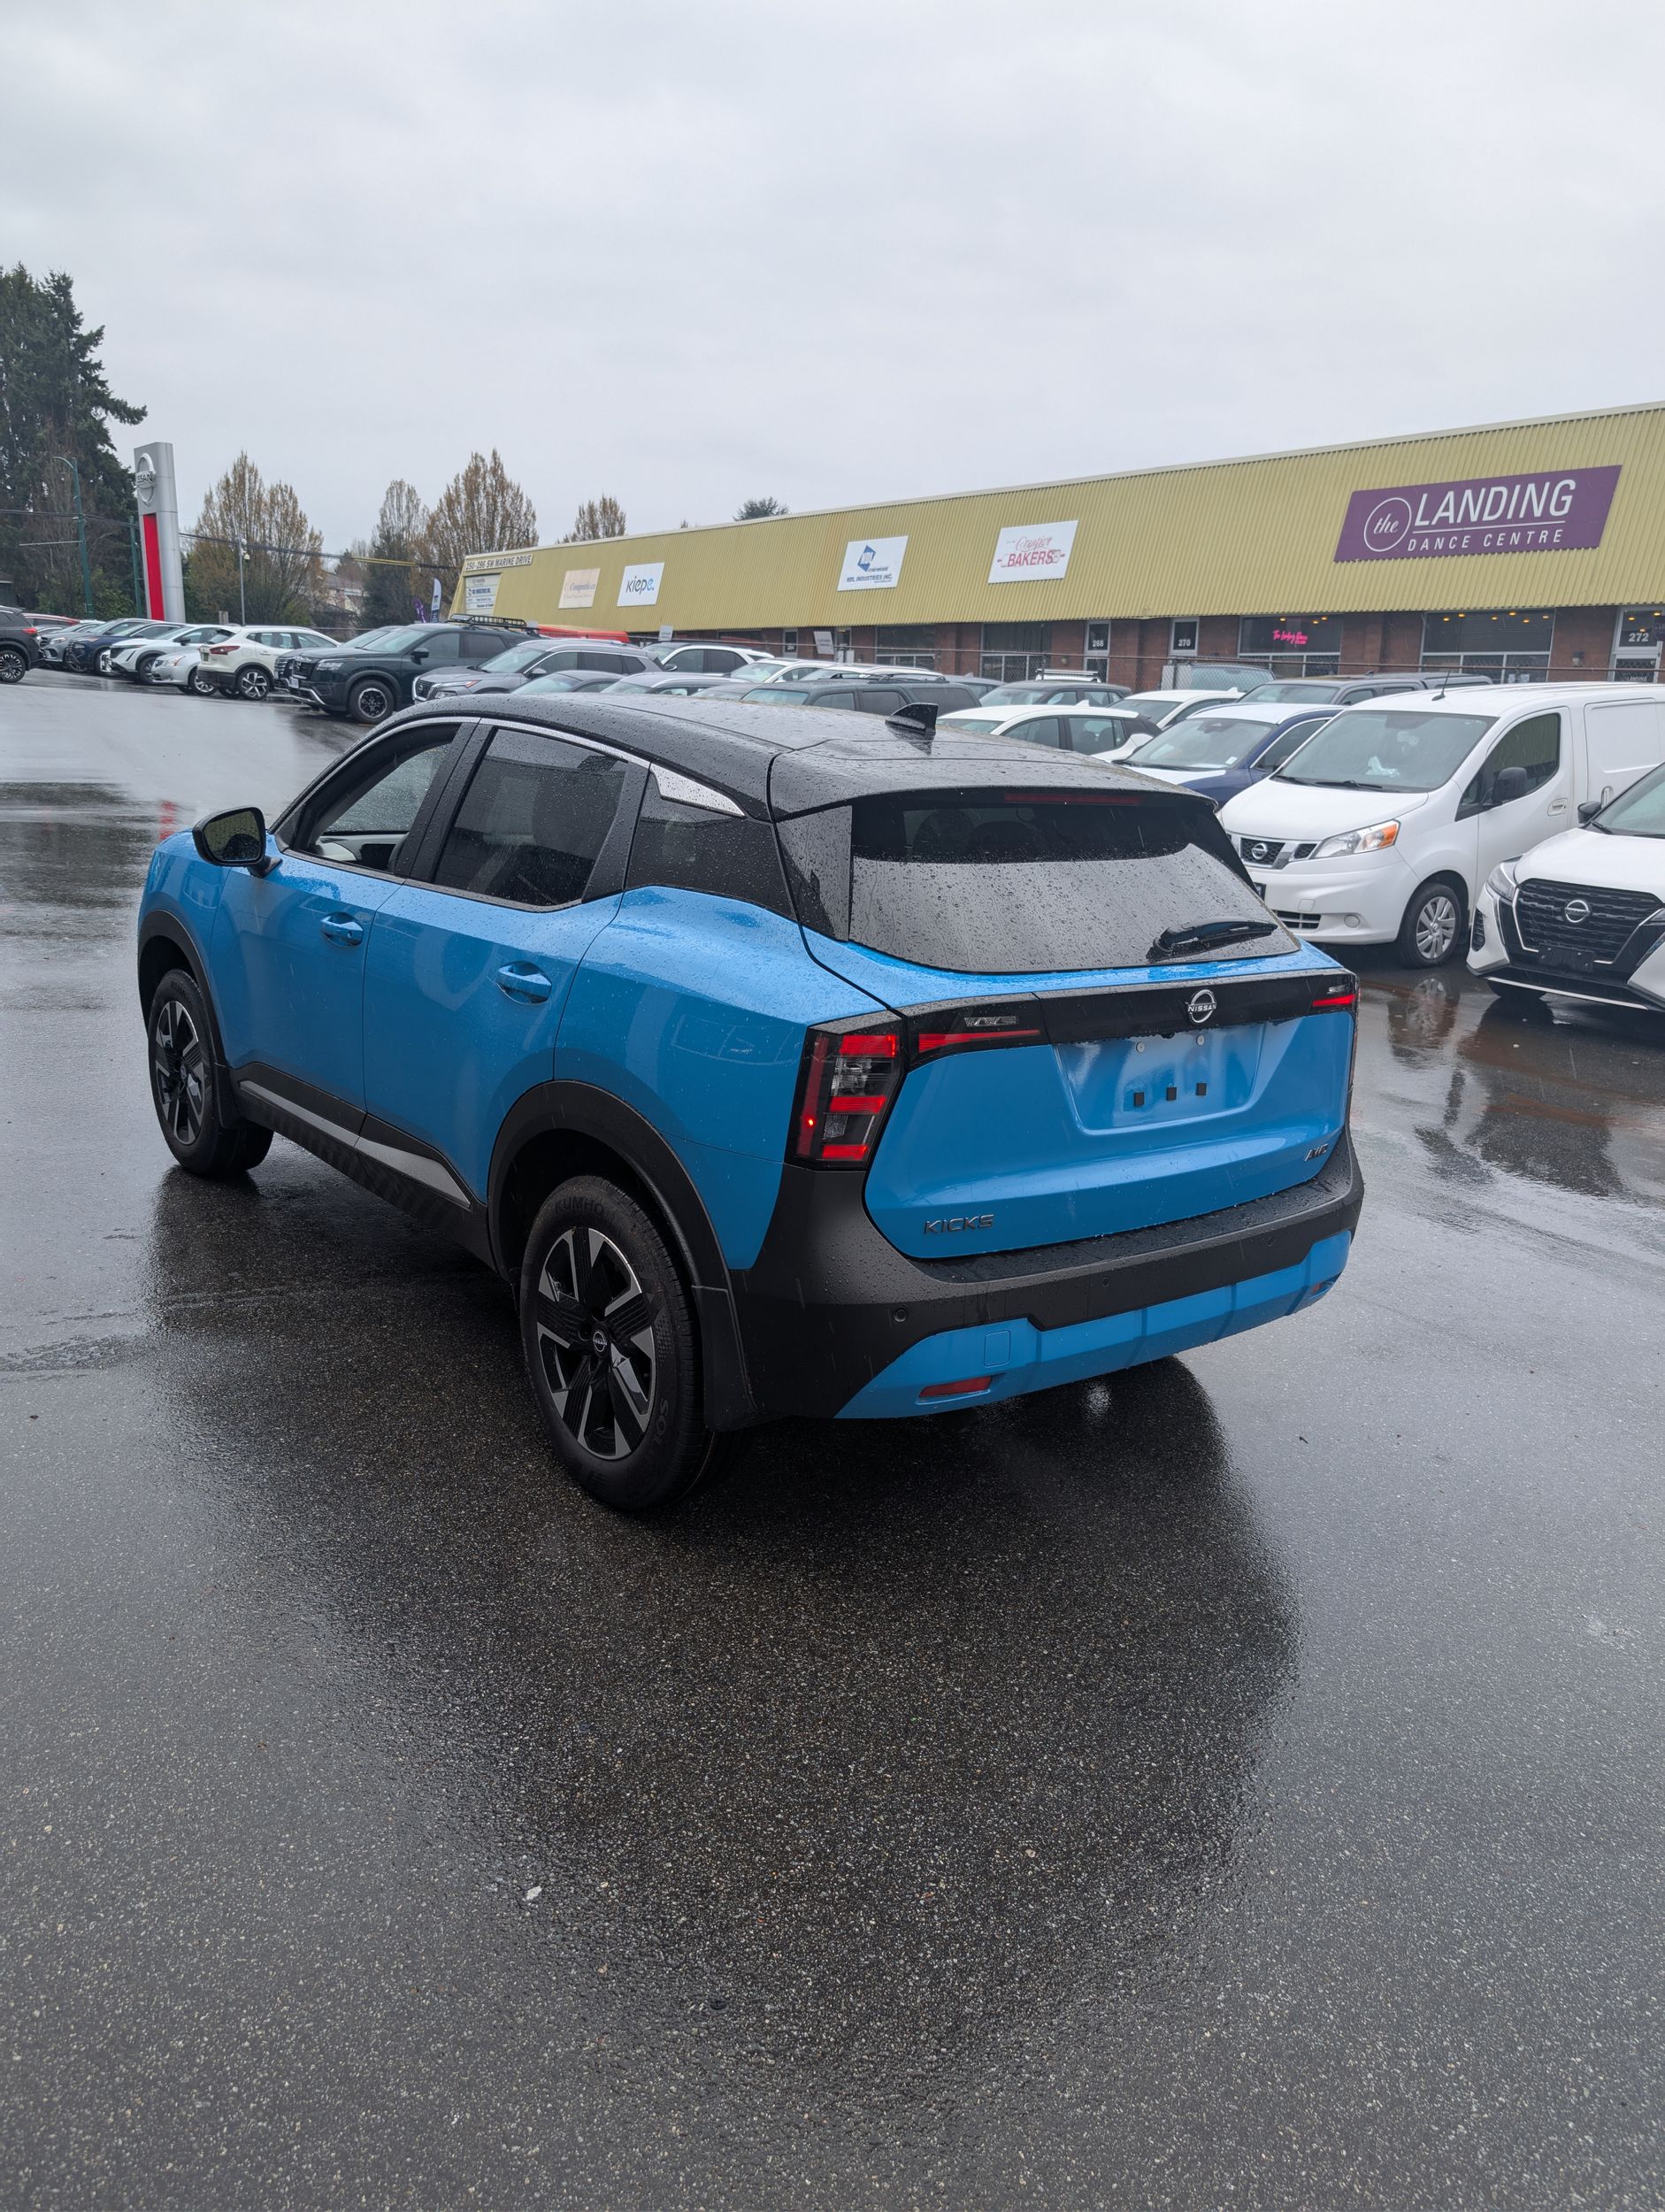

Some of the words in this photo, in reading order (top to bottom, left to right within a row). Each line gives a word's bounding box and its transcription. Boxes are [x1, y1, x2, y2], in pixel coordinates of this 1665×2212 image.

[1414, 479, 1576, 526] LANDING
[1373, 513, 1399, 534] the
[1407, 535, 1471, 552] DANCE
[1483, 529, 1563, 547] CENTRE
[495, 557, 515, 567] MARINE
[515, 555, 532, 565] DRIVE
[1007, 549, 1054, 567] BAKERS
[1628, 632, 1650, 642] 272
[1187, 1003, 1216, 1012] NISSAN
[923, 1213, 995, 1235] KICKS
